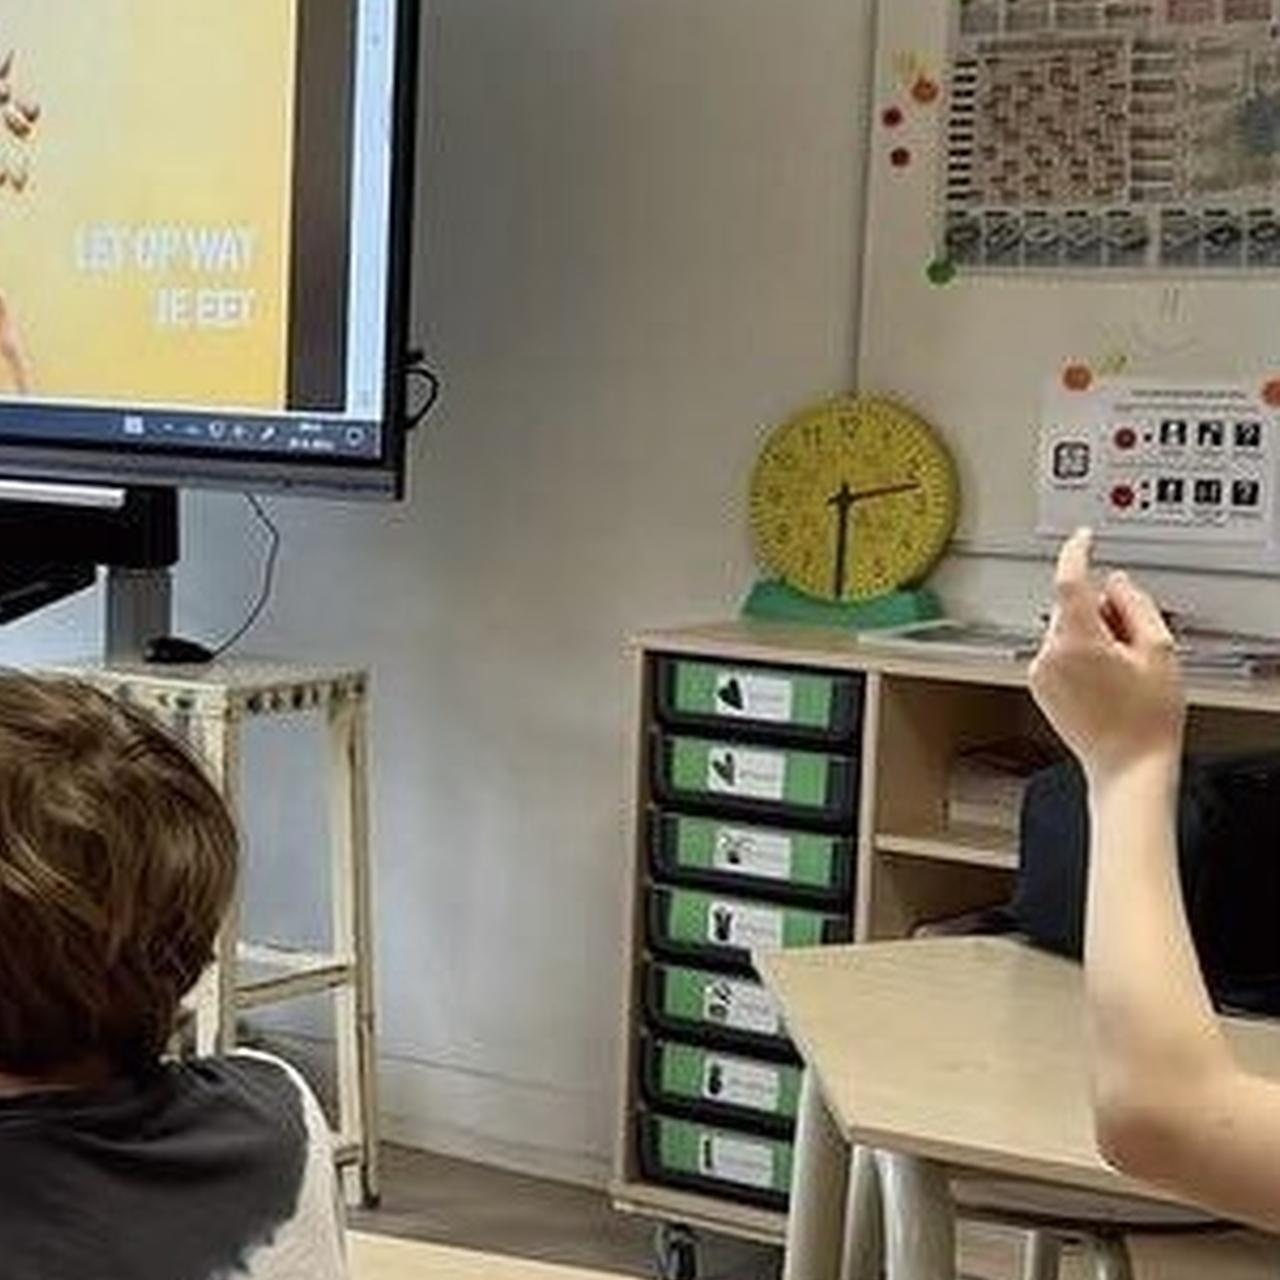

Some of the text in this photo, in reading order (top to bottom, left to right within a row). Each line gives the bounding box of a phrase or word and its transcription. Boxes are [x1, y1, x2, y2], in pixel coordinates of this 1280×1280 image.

[75, 223, 255, 273] LET OP WAT
